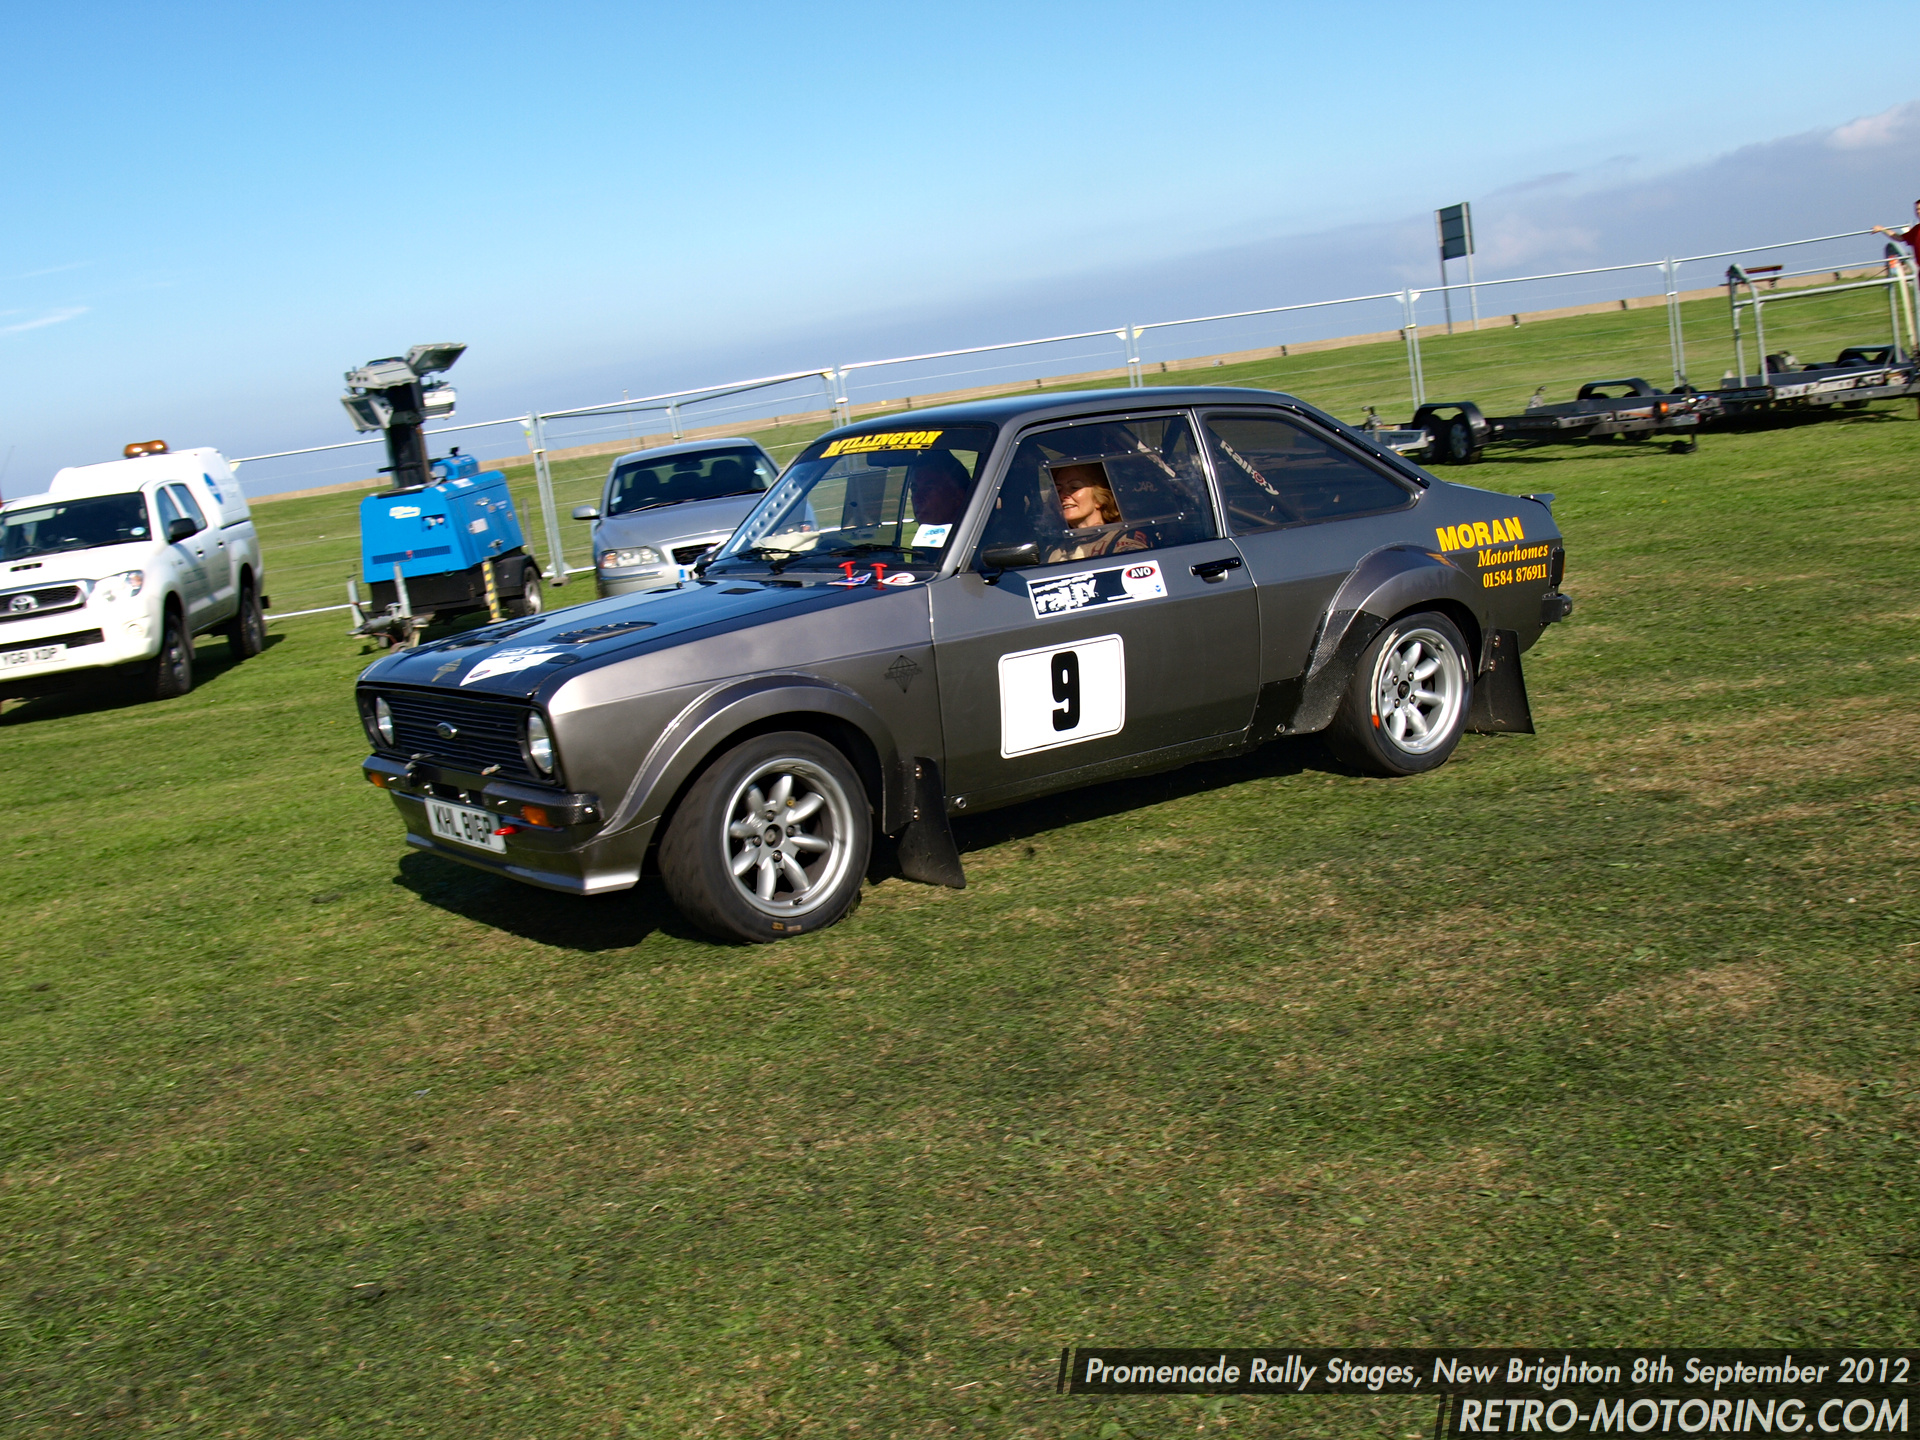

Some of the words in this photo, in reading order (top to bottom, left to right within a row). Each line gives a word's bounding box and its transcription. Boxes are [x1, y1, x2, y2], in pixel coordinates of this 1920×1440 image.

[819, 431, 943, 459] MILLINGTON
[1435, 516, 1525, 552] MORAN
[1477, 544, 1549, 568] Motorhomes
[1130, 567, 1151, 578] AVO
[1482, 568, 1513, 588] 01584
[1515, 563, 1547, 582] 876911
[1051, 650, 1080, 732] 9
[432, 804, 462, 838] KHL
